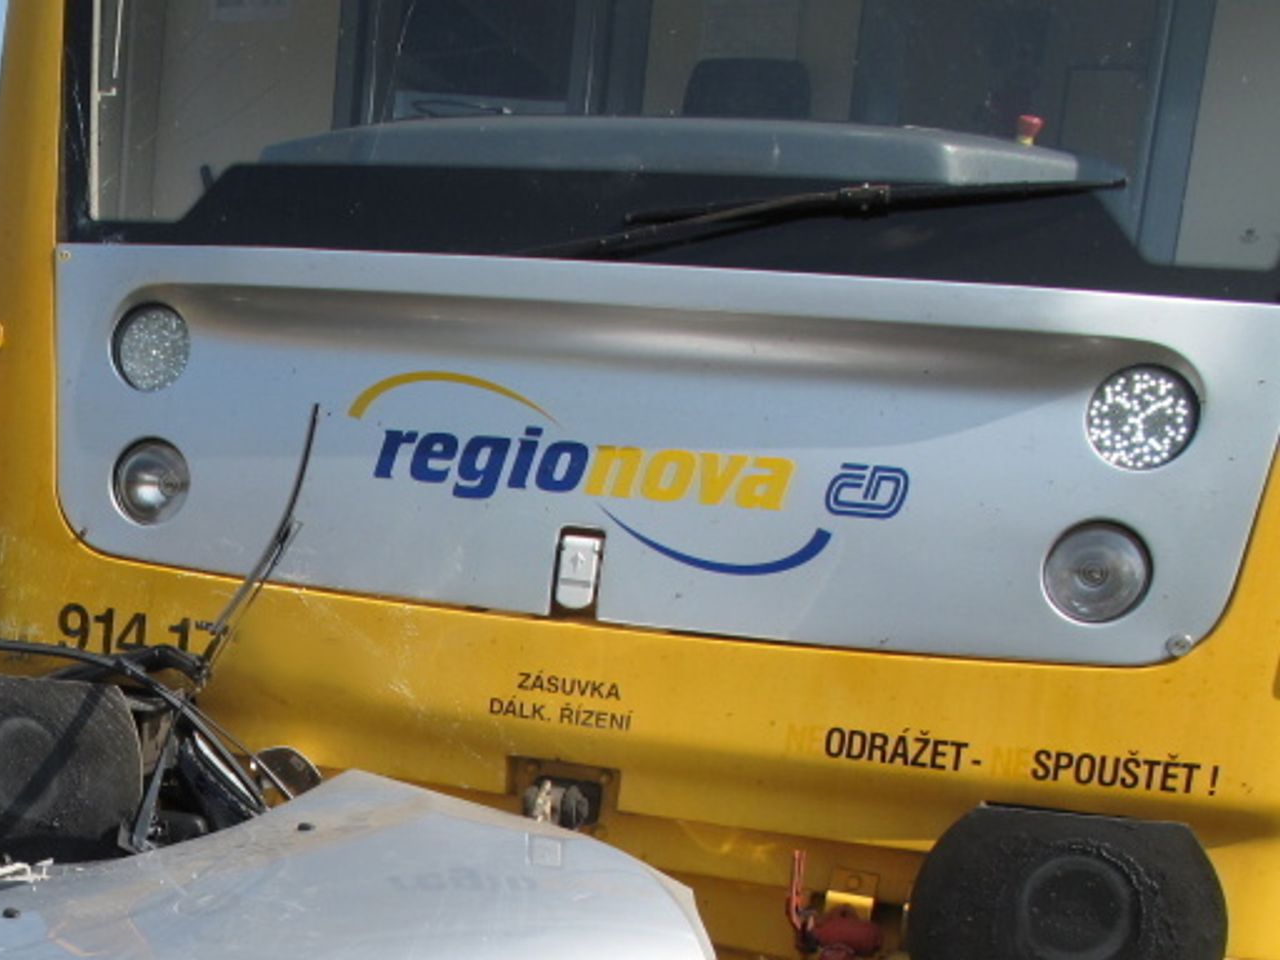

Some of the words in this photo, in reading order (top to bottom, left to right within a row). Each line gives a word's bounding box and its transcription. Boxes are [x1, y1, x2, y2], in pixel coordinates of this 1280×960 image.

[373, 426, 796, 511] regionova
[58, 602, 150, 656] 914
[517, 669, 621, 701] ZÁSUVKA
[489, 695, 551, 722] DÁLK.
[560, 702, 633, 731] ŘÍZENÍ
